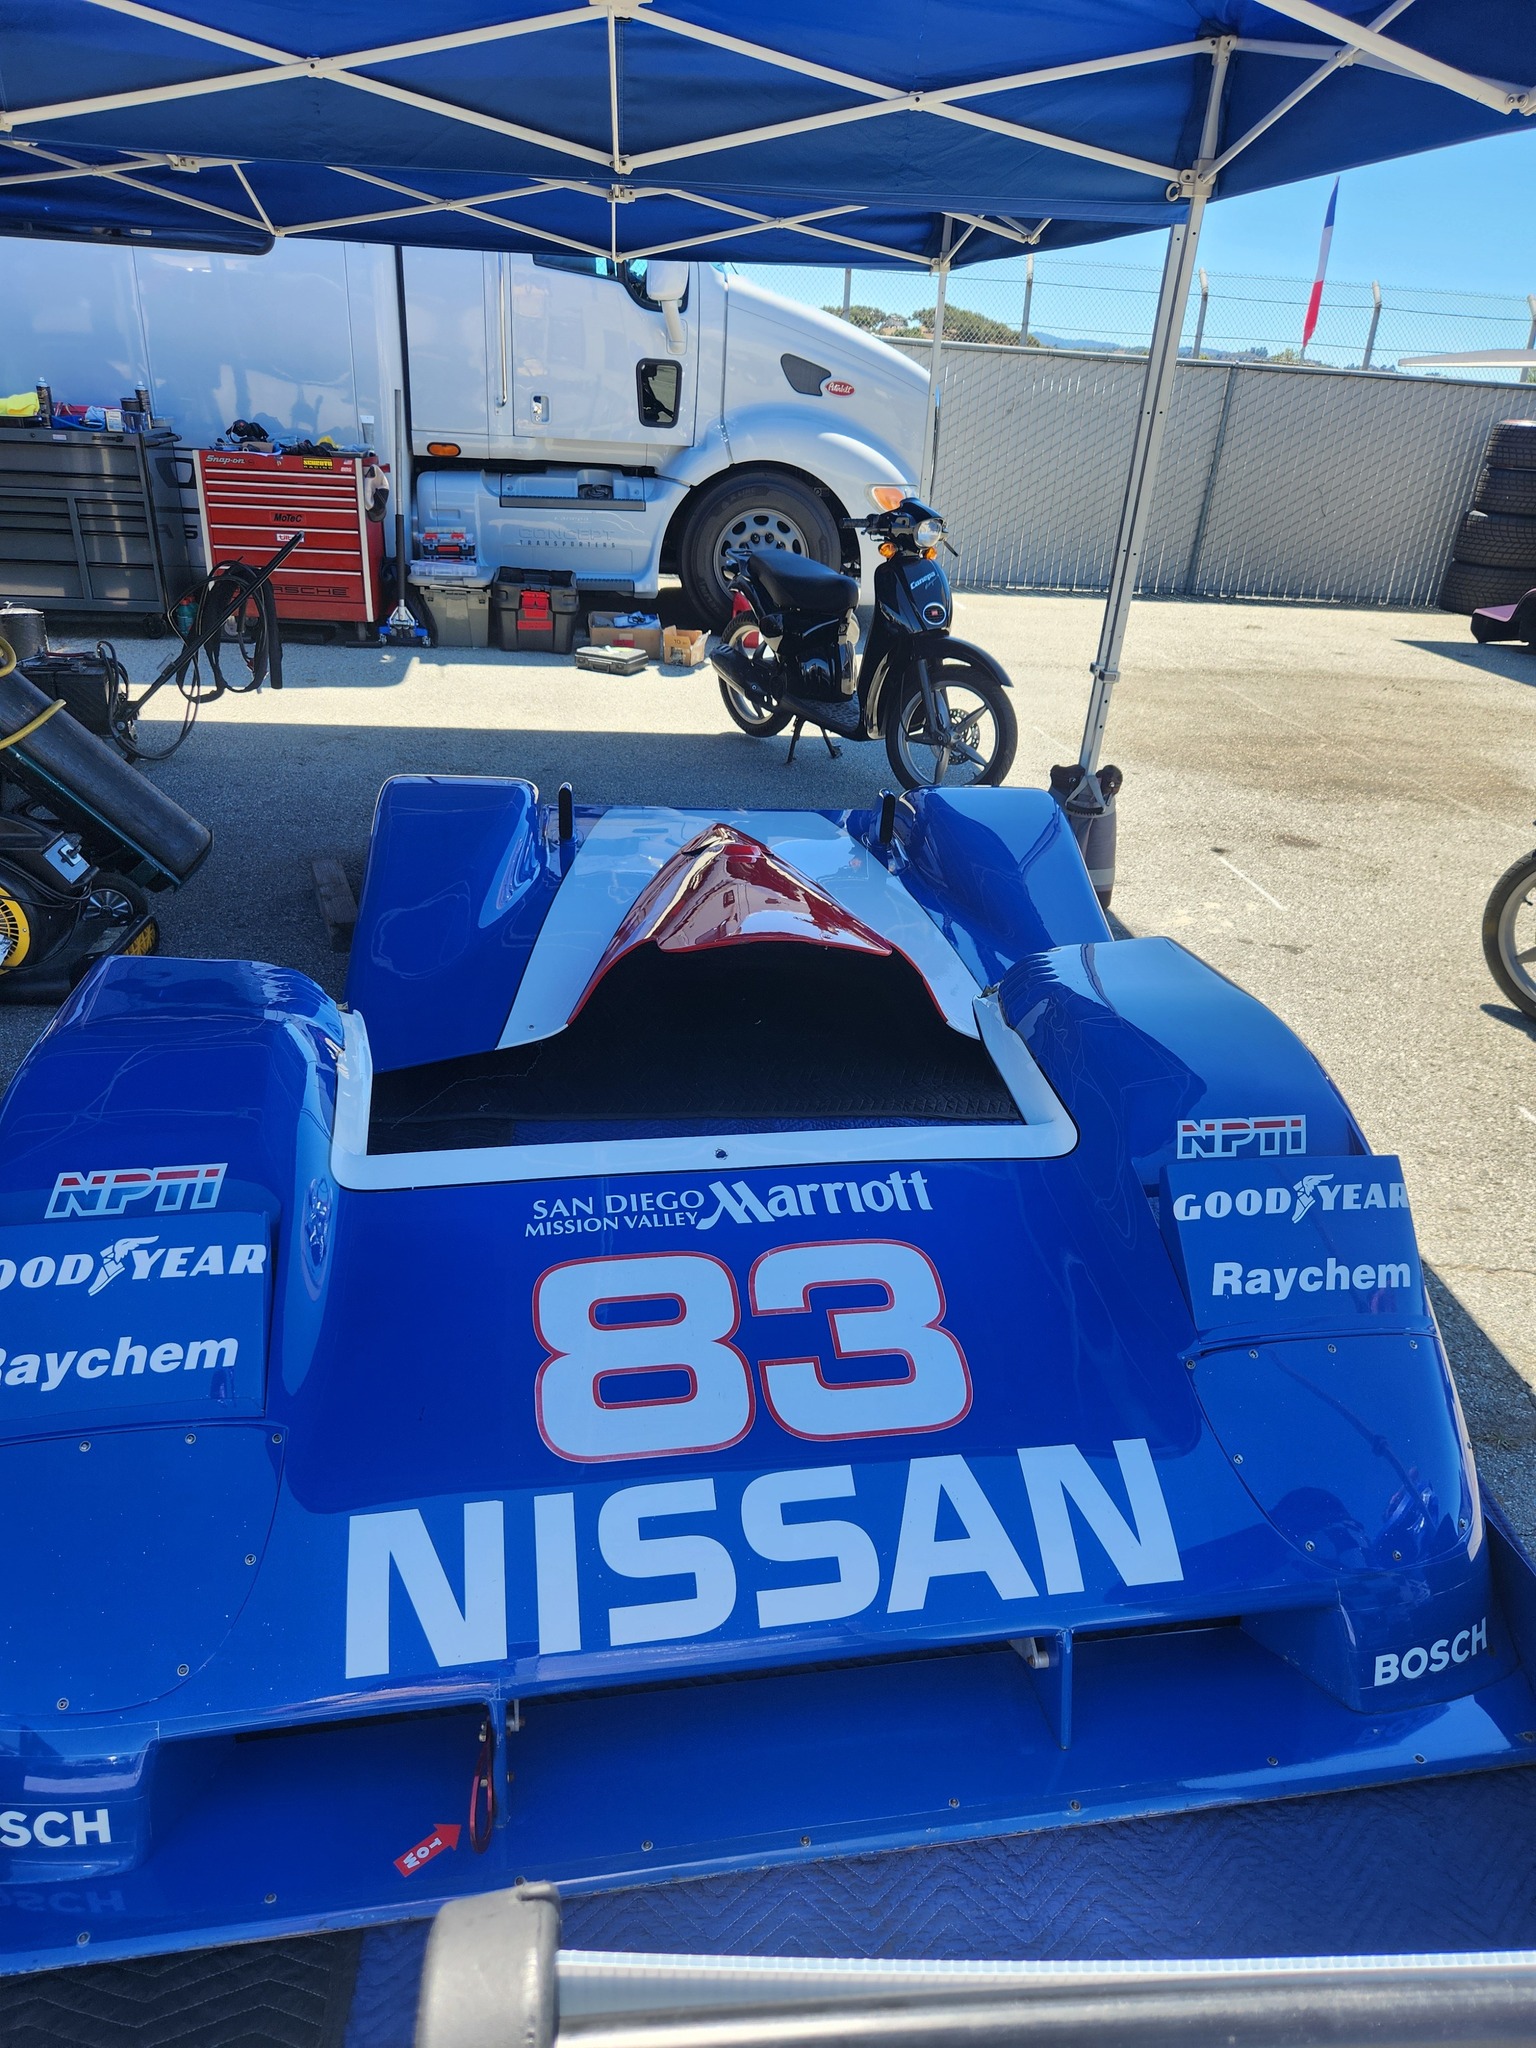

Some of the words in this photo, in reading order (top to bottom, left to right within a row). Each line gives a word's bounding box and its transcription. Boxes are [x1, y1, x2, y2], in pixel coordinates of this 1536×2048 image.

[205, 455, 245, 464] Snap-on
[274, 513, 303, 523] MoTeC
[519, 527, 615, 541] CONCEPT
[519, 540, 616, 548] TRANSPORTERS
[273, 586, 347, 596] RSCHE
[910, 571, 936, 590] Canepa
[533, 1196, 594, 1220] SAN
[604, 1190, 705, 1214] DIEGO
[695, 1170, 934, 1231] Marriott
[1173, 1183, 1410, 1221] GOODYEAR
[525, 1215, 619, 1237] MISSION
[623, 1211, 699, 1230] VALLEY
[1212, 1257, 1412, 1301] Raychem
[0, 1336, 239, 1392] aychem
[533, 1239, 973, 1463] 83
[345, 1438, 1184, 1680] NISSAN
[1374, 1616, 1488, 1687] BOSCH
[403, 1837, 443, 1869] TOW
